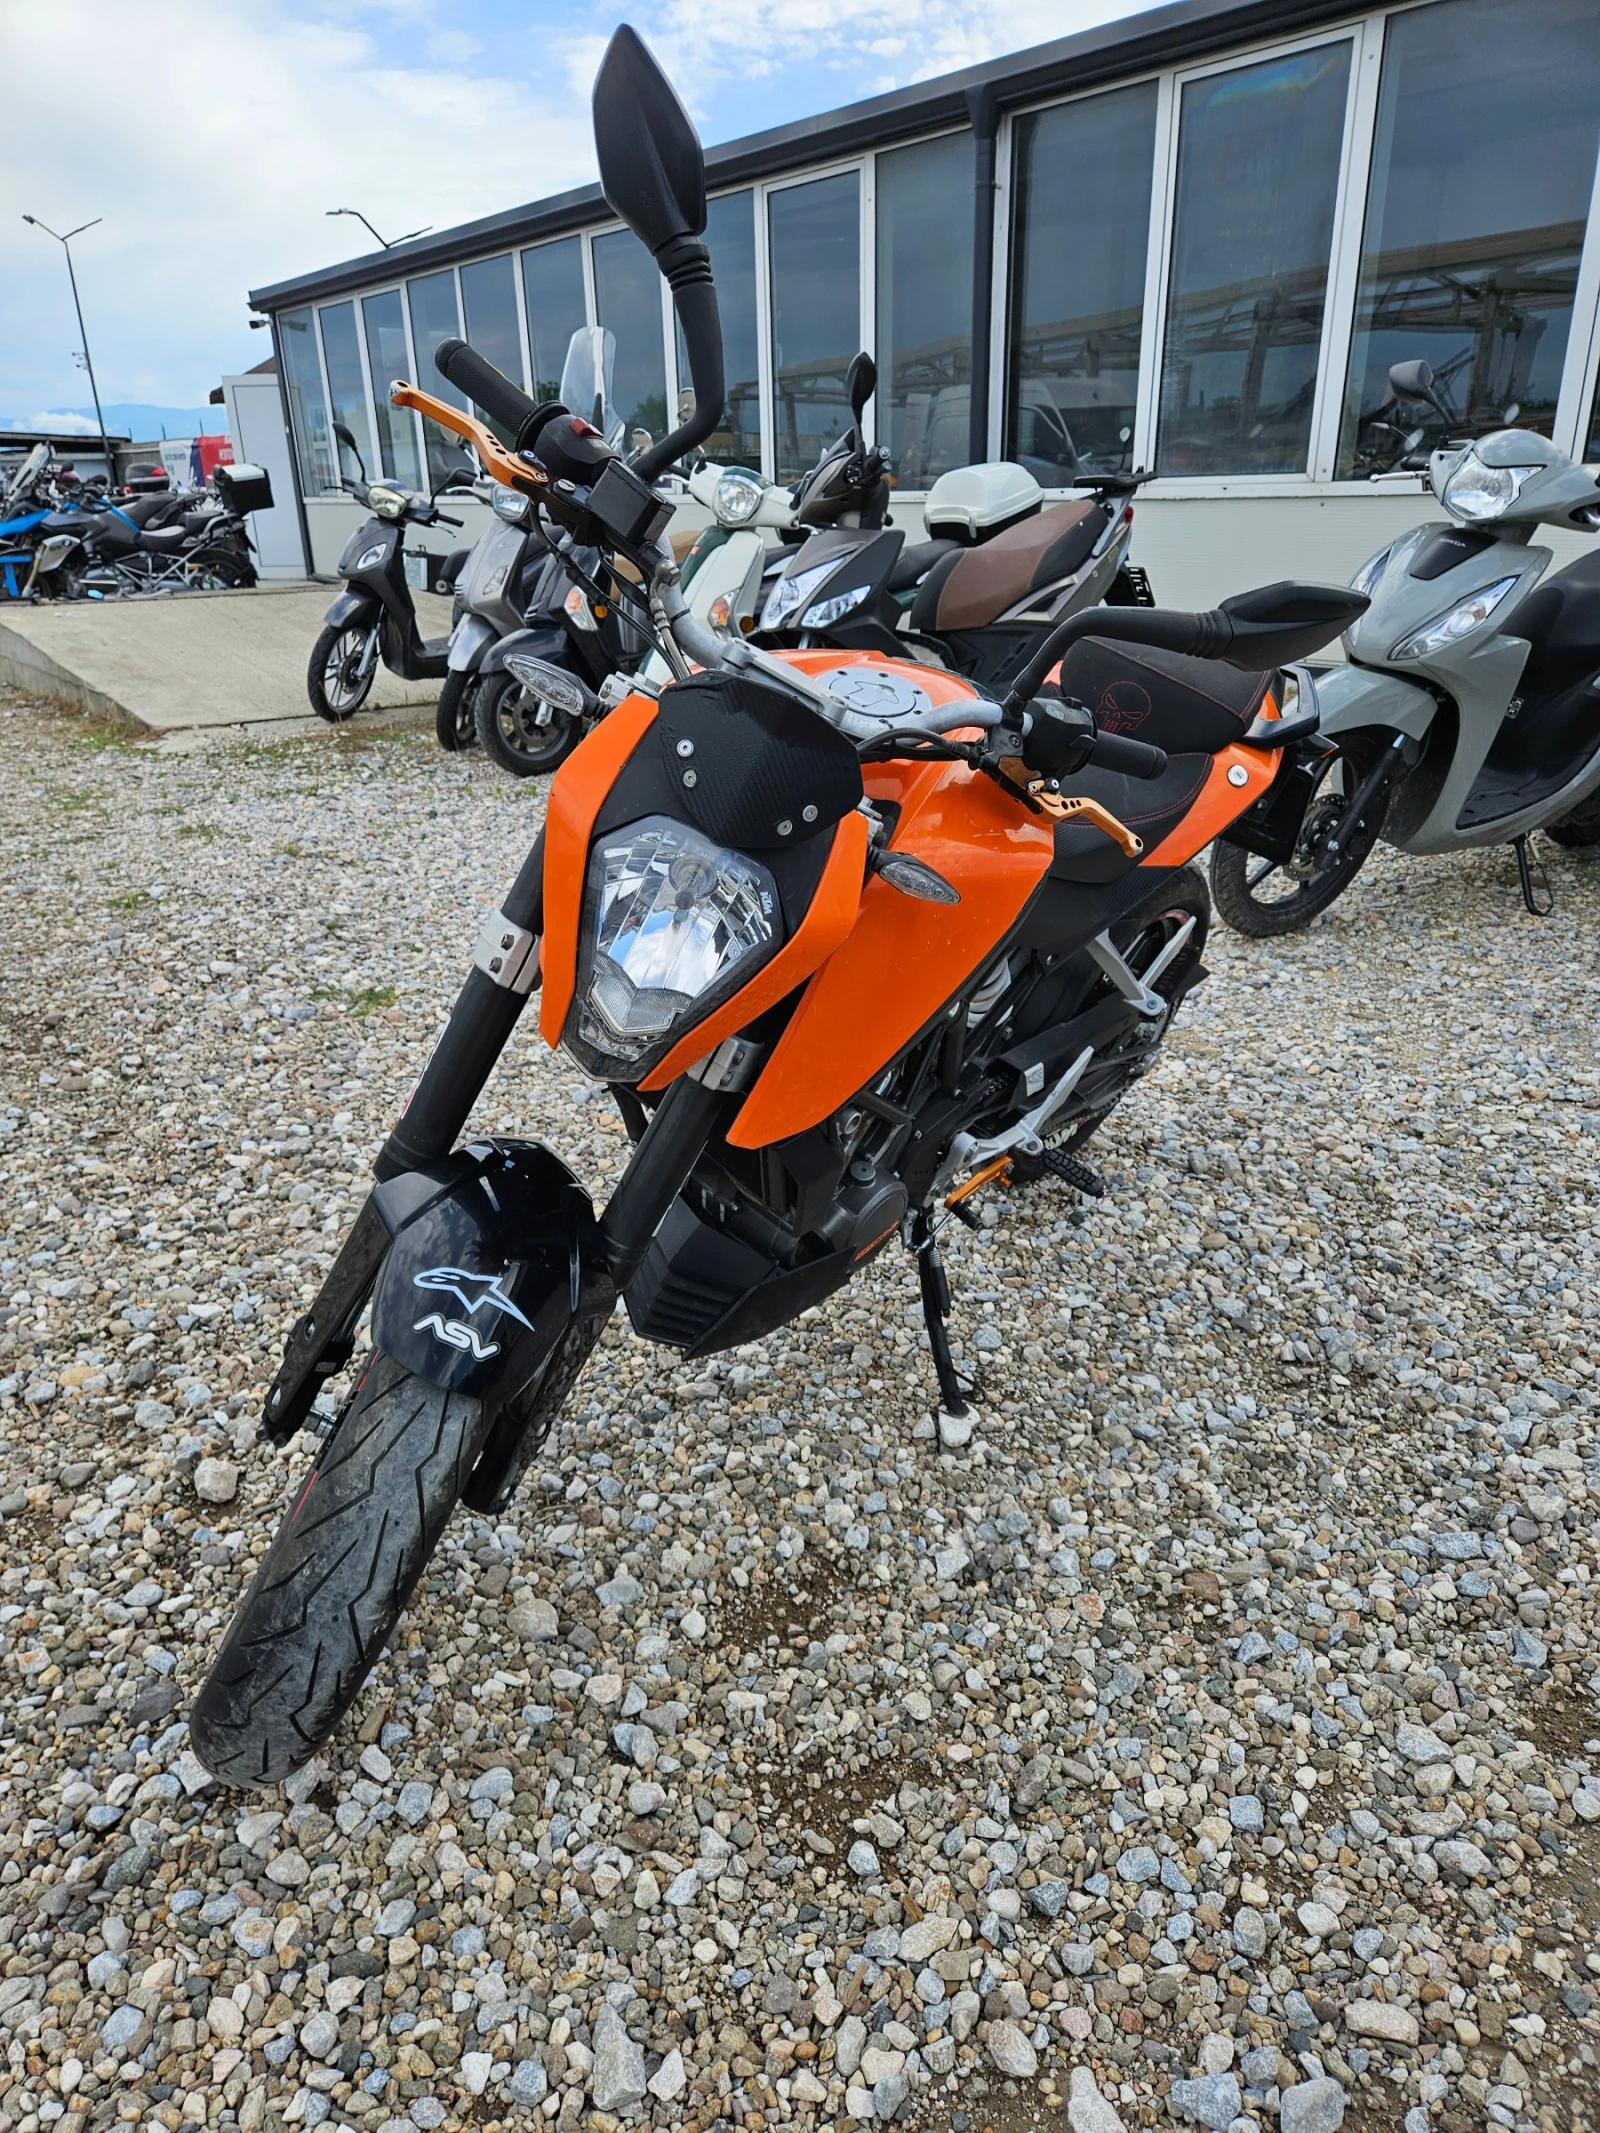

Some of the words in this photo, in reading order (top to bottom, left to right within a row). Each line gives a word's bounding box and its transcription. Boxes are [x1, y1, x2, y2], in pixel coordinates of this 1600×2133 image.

[1438, 537, 1467, 548] HONDA
[759, 891, 773, 915] KTM
[412, 1313, 499, 1360] ASV
